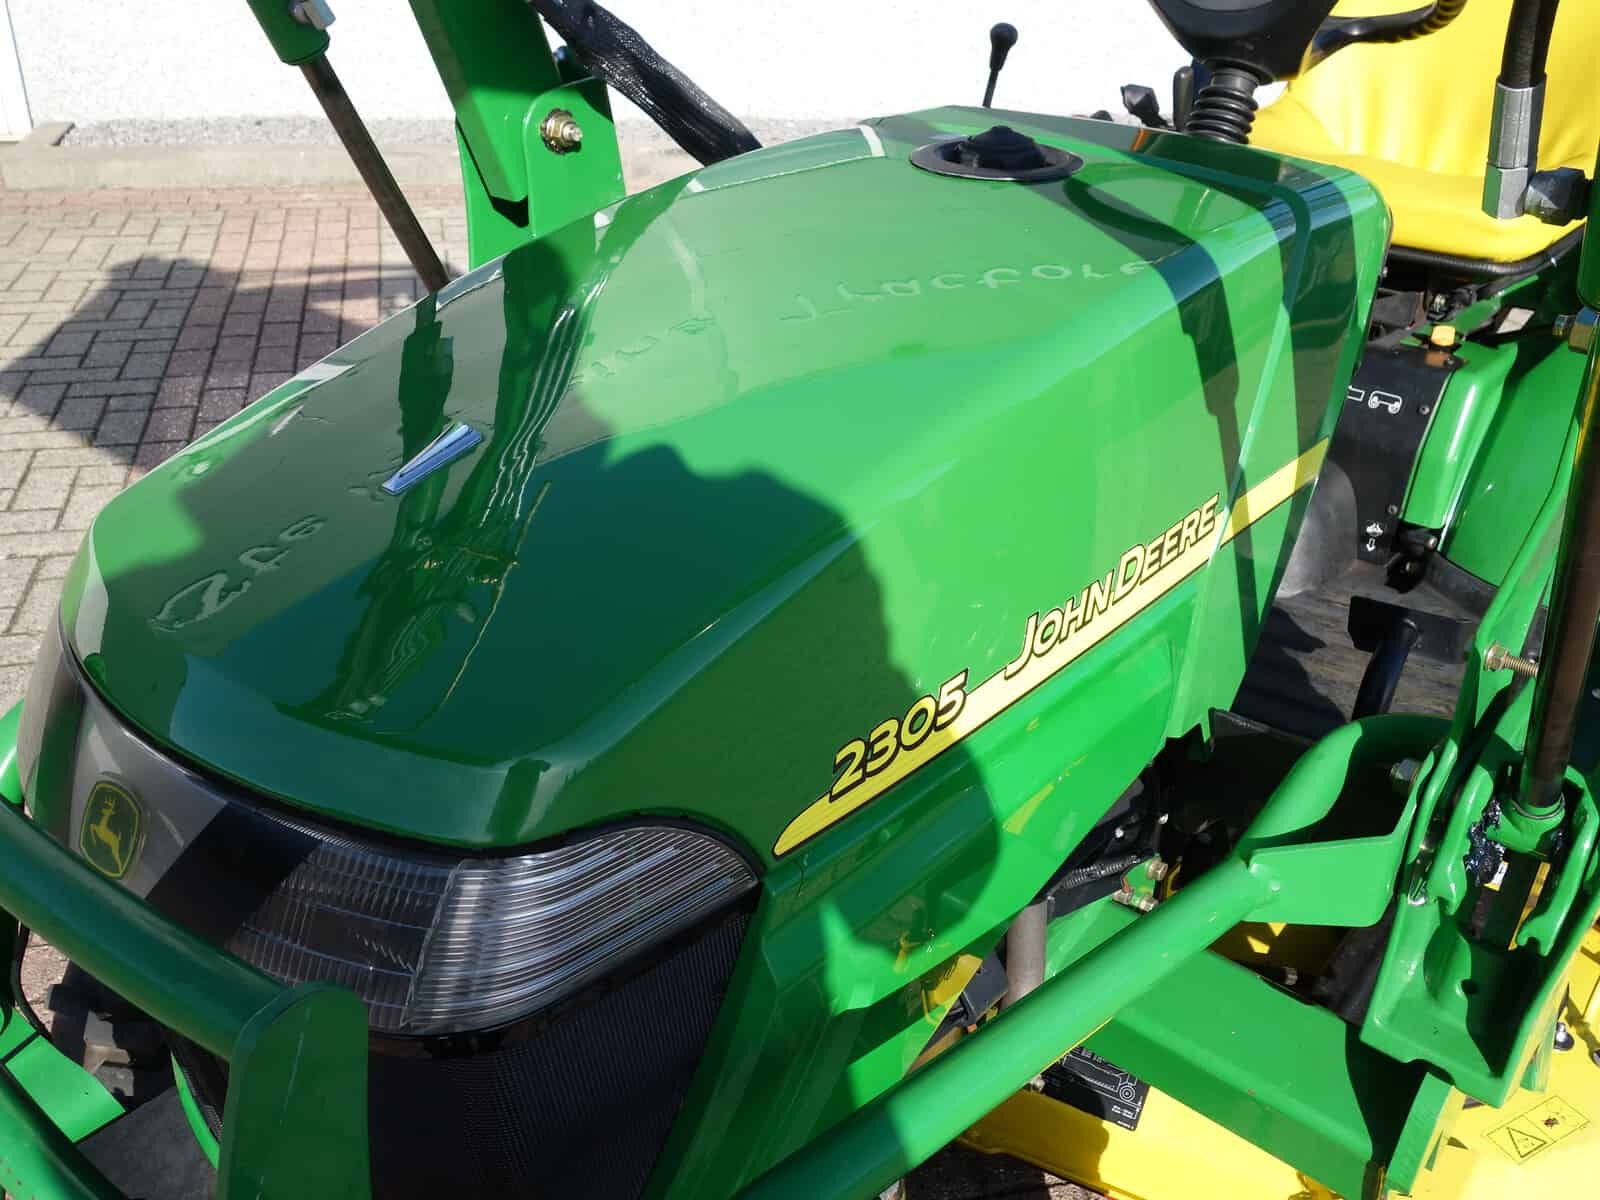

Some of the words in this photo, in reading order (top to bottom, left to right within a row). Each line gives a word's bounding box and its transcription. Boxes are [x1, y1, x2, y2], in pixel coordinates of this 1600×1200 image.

[1004, 568, 1115, 680] JOHN
[1112, 492, 1220, 606] DEERE
[829, 667, 969, 804] 2305
